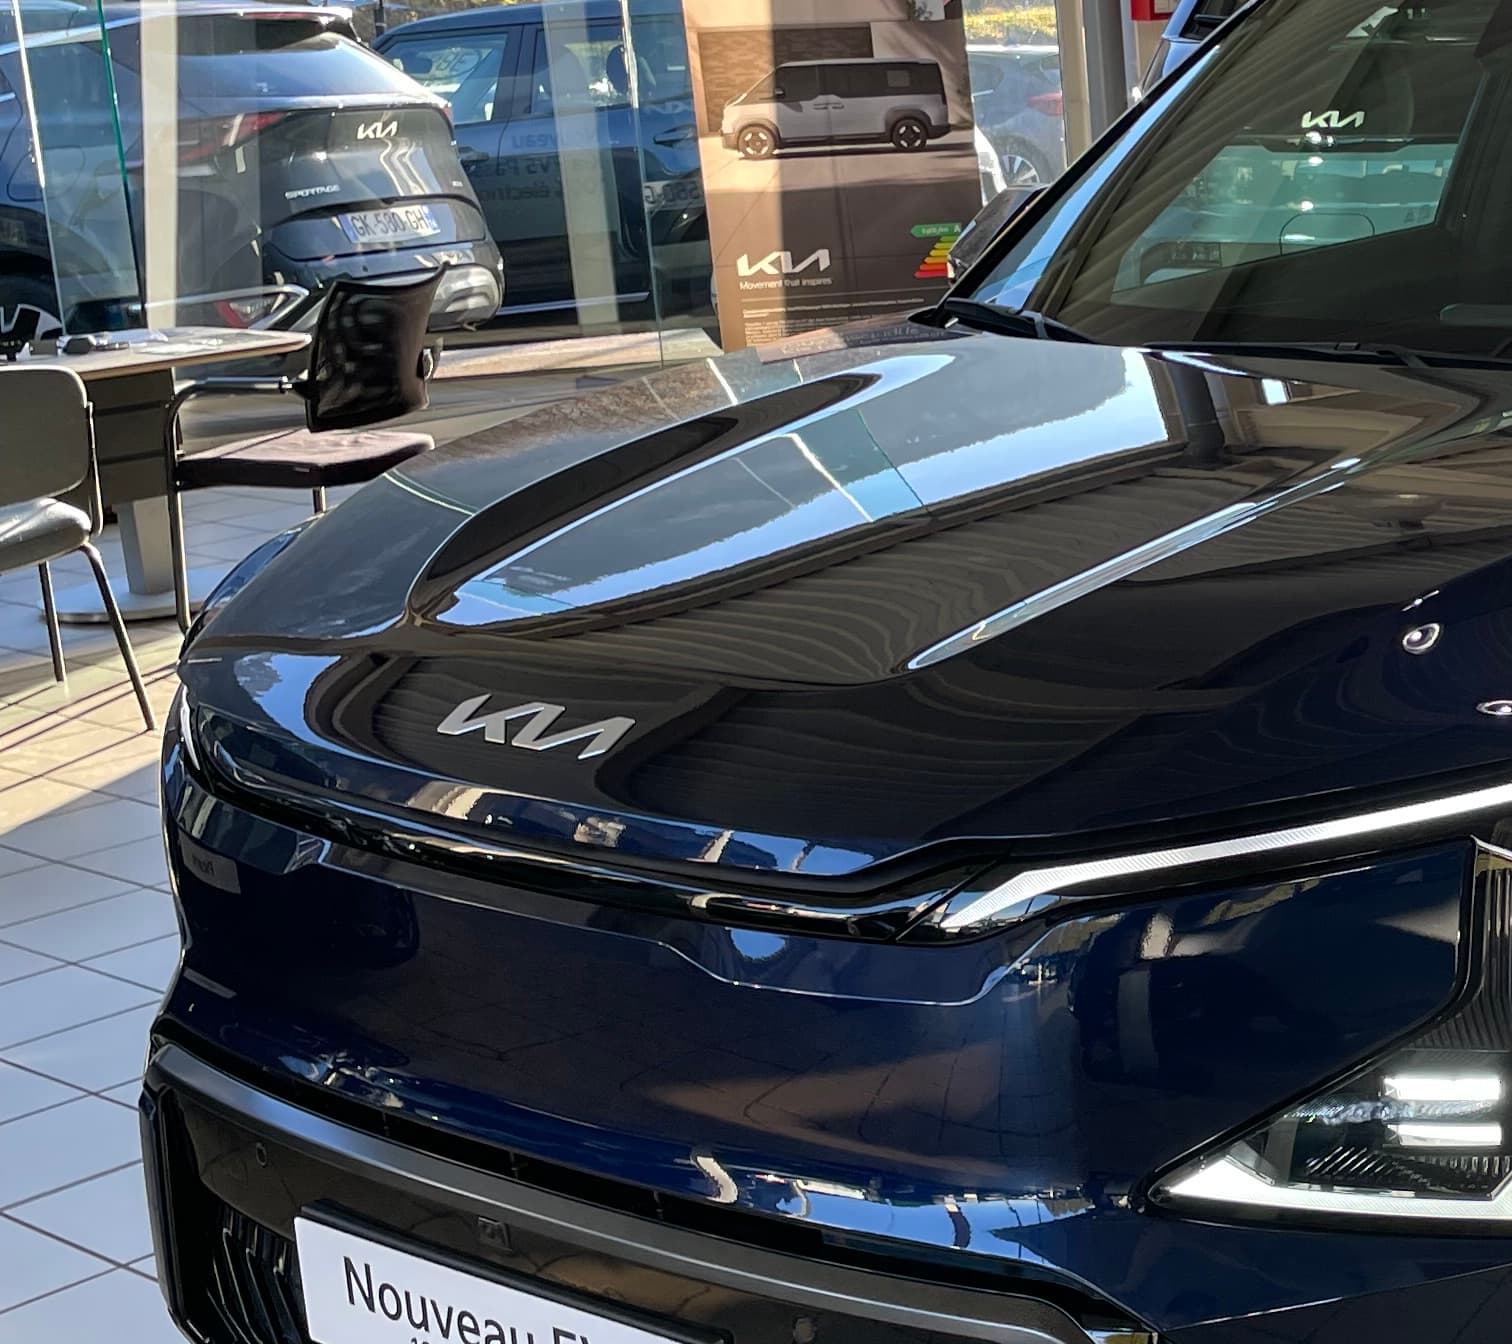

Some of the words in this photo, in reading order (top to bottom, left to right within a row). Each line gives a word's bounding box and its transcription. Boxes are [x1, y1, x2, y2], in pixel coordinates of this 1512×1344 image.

[1301, 110, 1365, 128] KIA
[357, 121, 398, 140] KIA
[737, 248, 831, 277] KIA
[739, 278, 782, 291] Movement
[801, 277, 833, 287] inspires
[436, 693, 637, 761] KIA
